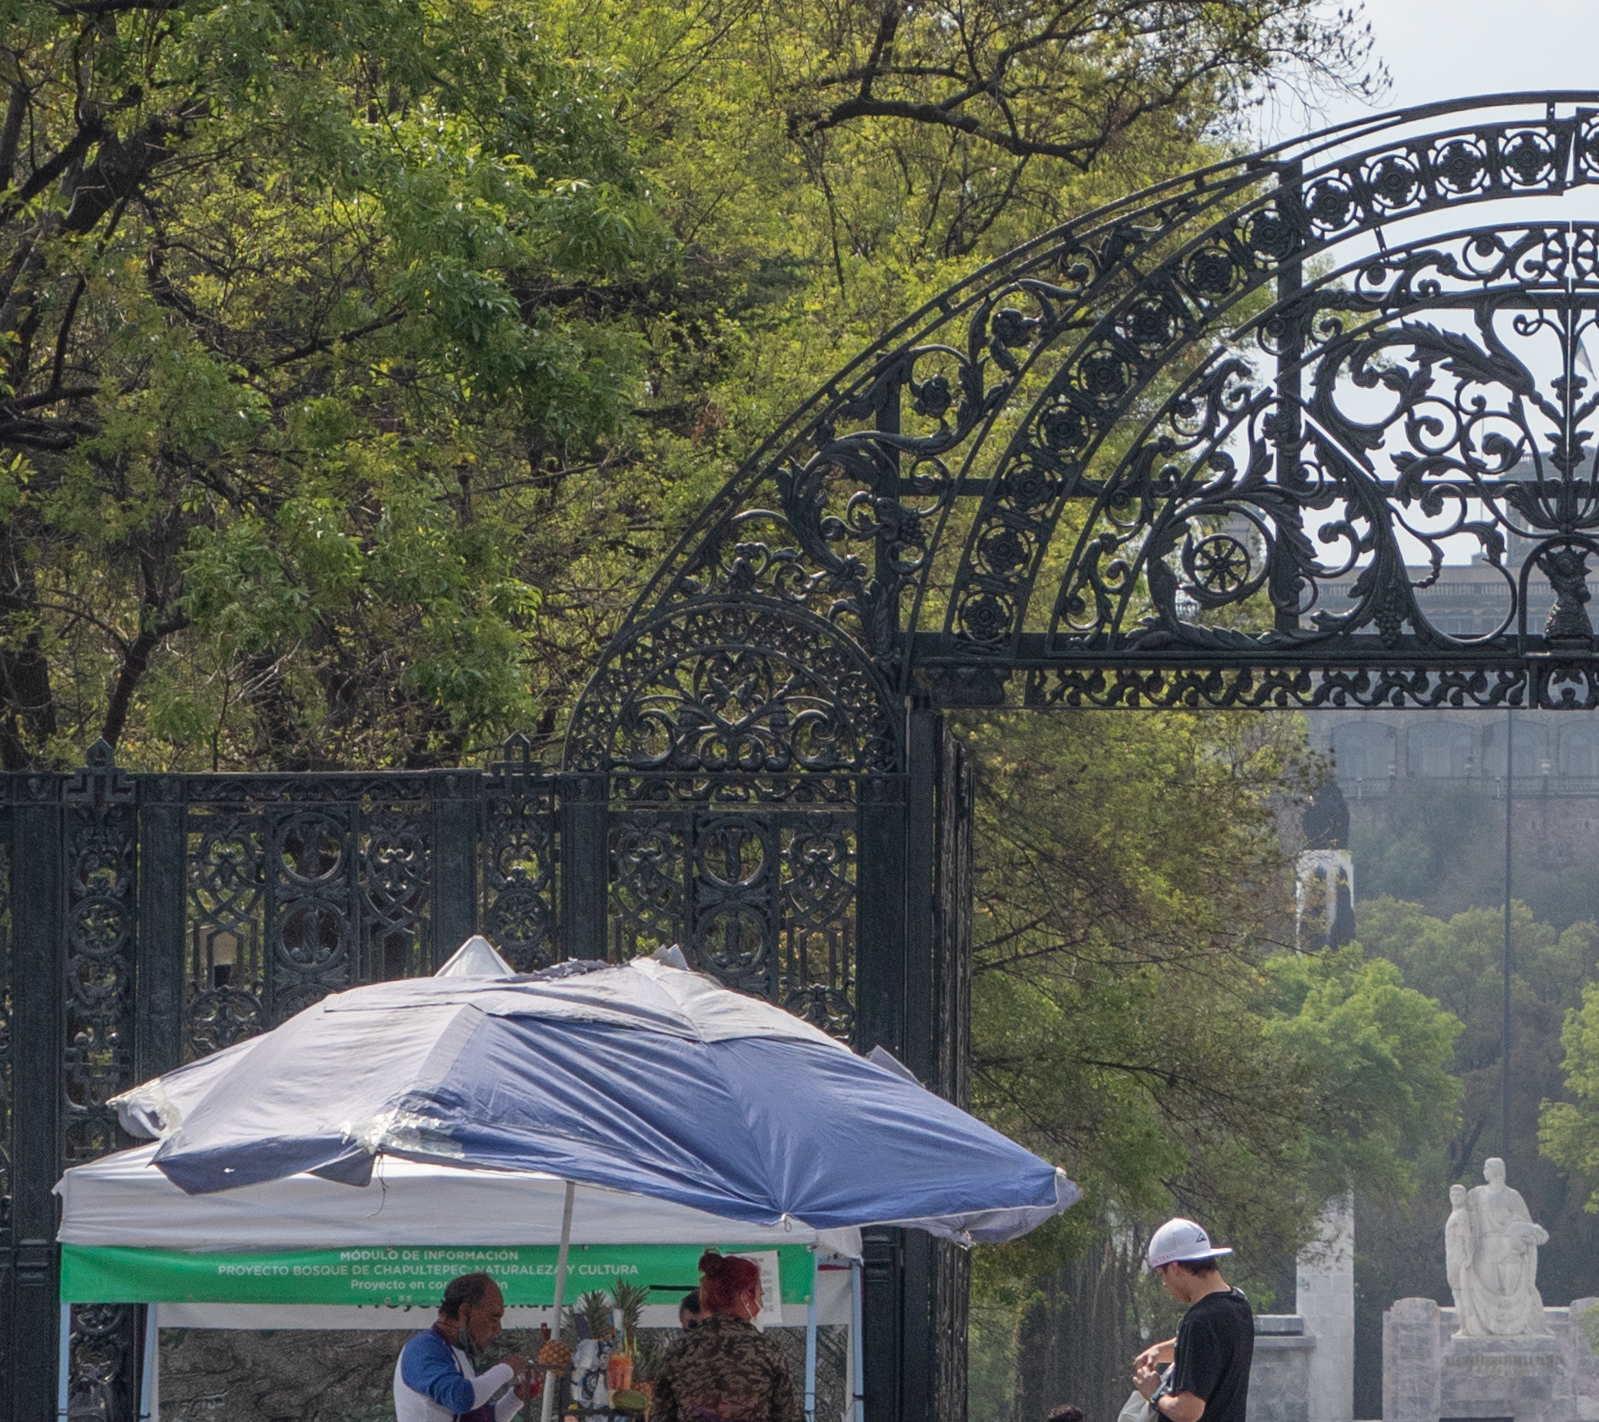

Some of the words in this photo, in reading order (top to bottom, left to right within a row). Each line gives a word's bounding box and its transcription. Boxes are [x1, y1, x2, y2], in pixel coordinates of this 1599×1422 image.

[340, 1249, 398, 1261] MÓDULO
[402, 1250, 420, 1261] DE
[423, 1249, 519, 1261] INFORMACIÓN
[217, 1265, 289, 1276] PROYECTO
[292, 1264, 348, 1276] BOSQUE
[352, 1264, 369, 1275] DE
[566, 1264, 575, 1275] Y
[578, 1264, 639, 1275] CULTURA
[350, 1280, 406, 1291] Proyecto
[409, 1281, 425, 1290] en
